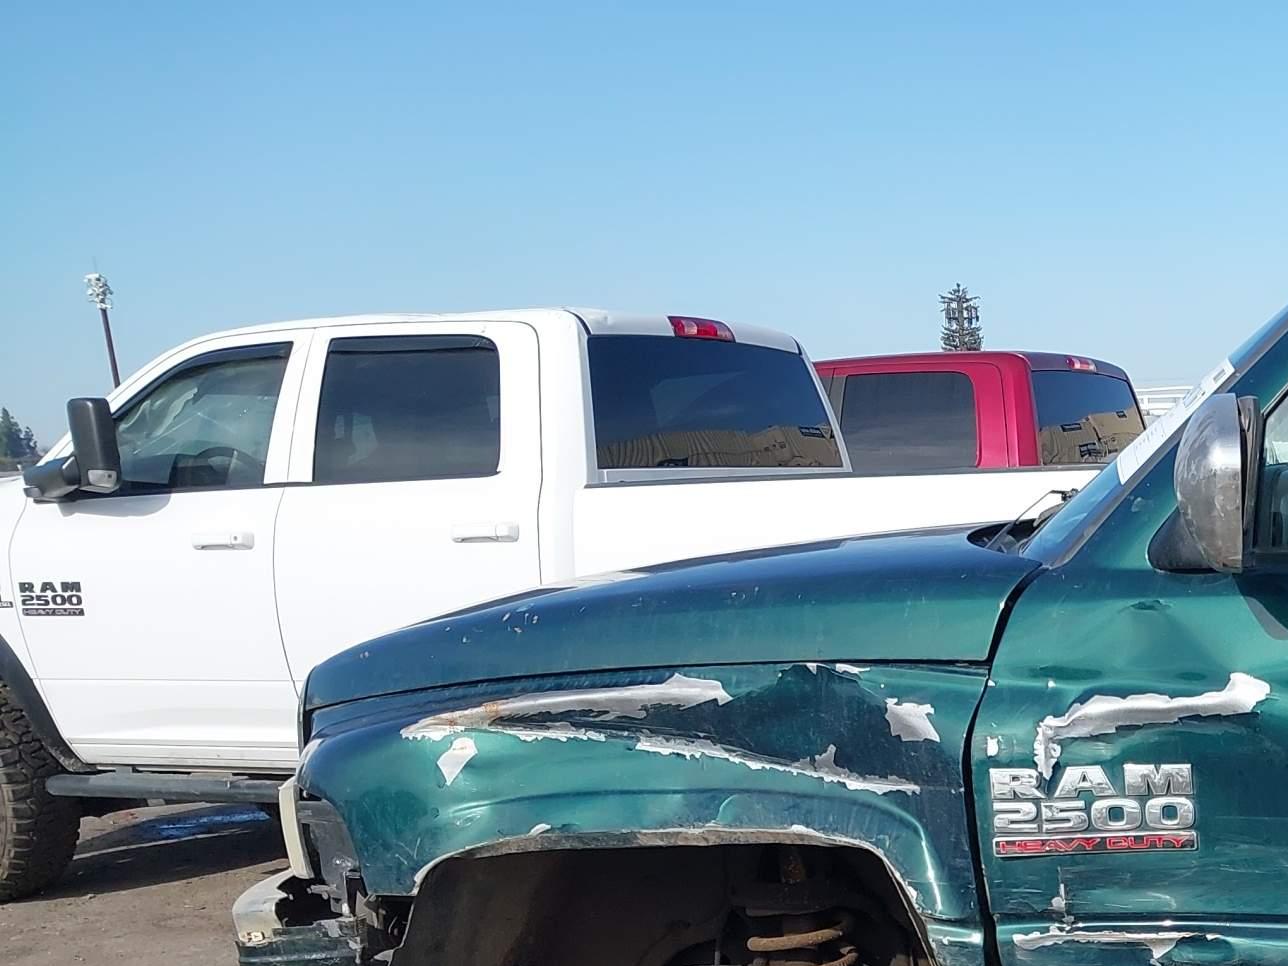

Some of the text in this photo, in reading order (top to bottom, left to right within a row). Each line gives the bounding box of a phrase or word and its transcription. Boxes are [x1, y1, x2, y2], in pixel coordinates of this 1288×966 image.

[18, 582, 81, 593] RAM
[20, 594, 82, 606] 2500
[989, 763, 1194, 799] RAM
[992, 797, 1195, 833] 2500
[1000, 835, 1189, 854] HEAVY DUTY
